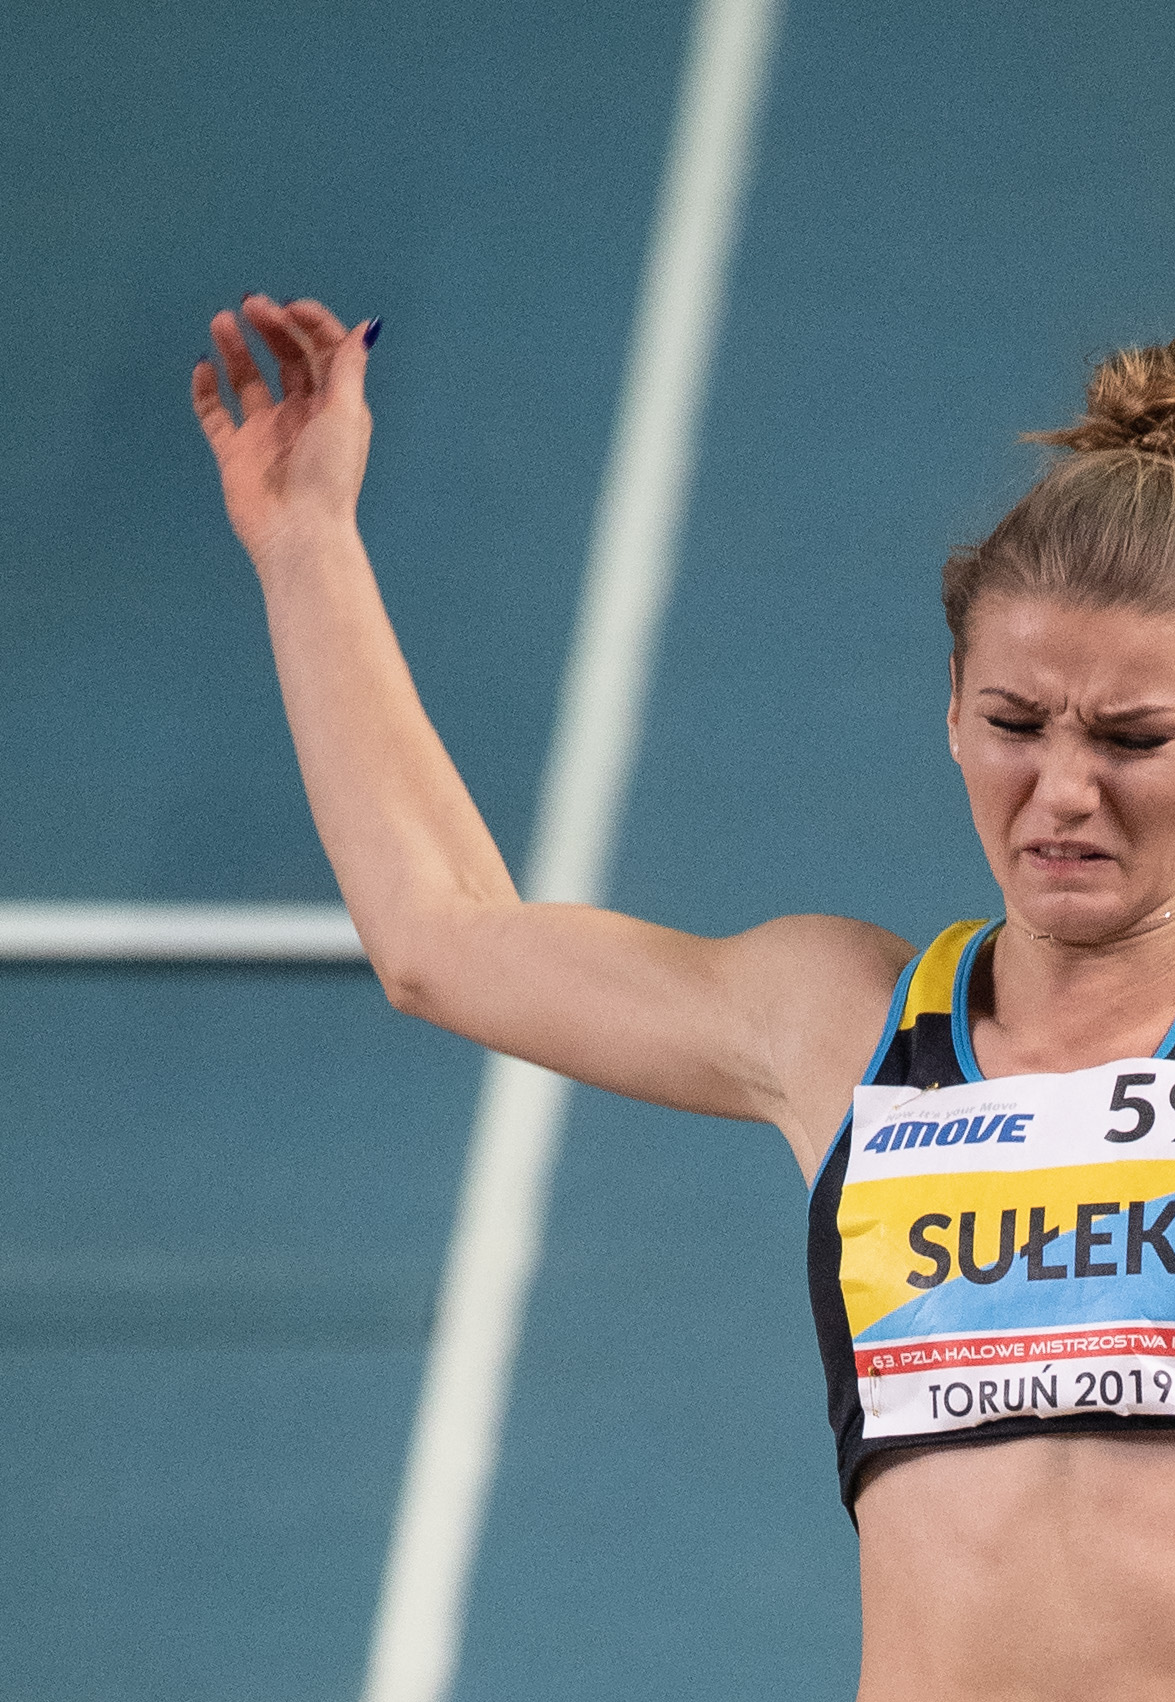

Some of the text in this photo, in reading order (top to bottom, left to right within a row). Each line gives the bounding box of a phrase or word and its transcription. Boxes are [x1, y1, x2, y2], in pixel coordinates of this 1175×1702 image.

[864, 1113, 1035, 1154] 4MOVE
[872, 1354, 899, 1369] 63.
[900, 1350, 943, 1365] PZLA
[945, 1343, 1025, 1360] HALOWE
[1029, 1334, 1168, 1355] MISTRZOSTWA
[929, 1363, 1173, 1419] TORUŃ 2019
